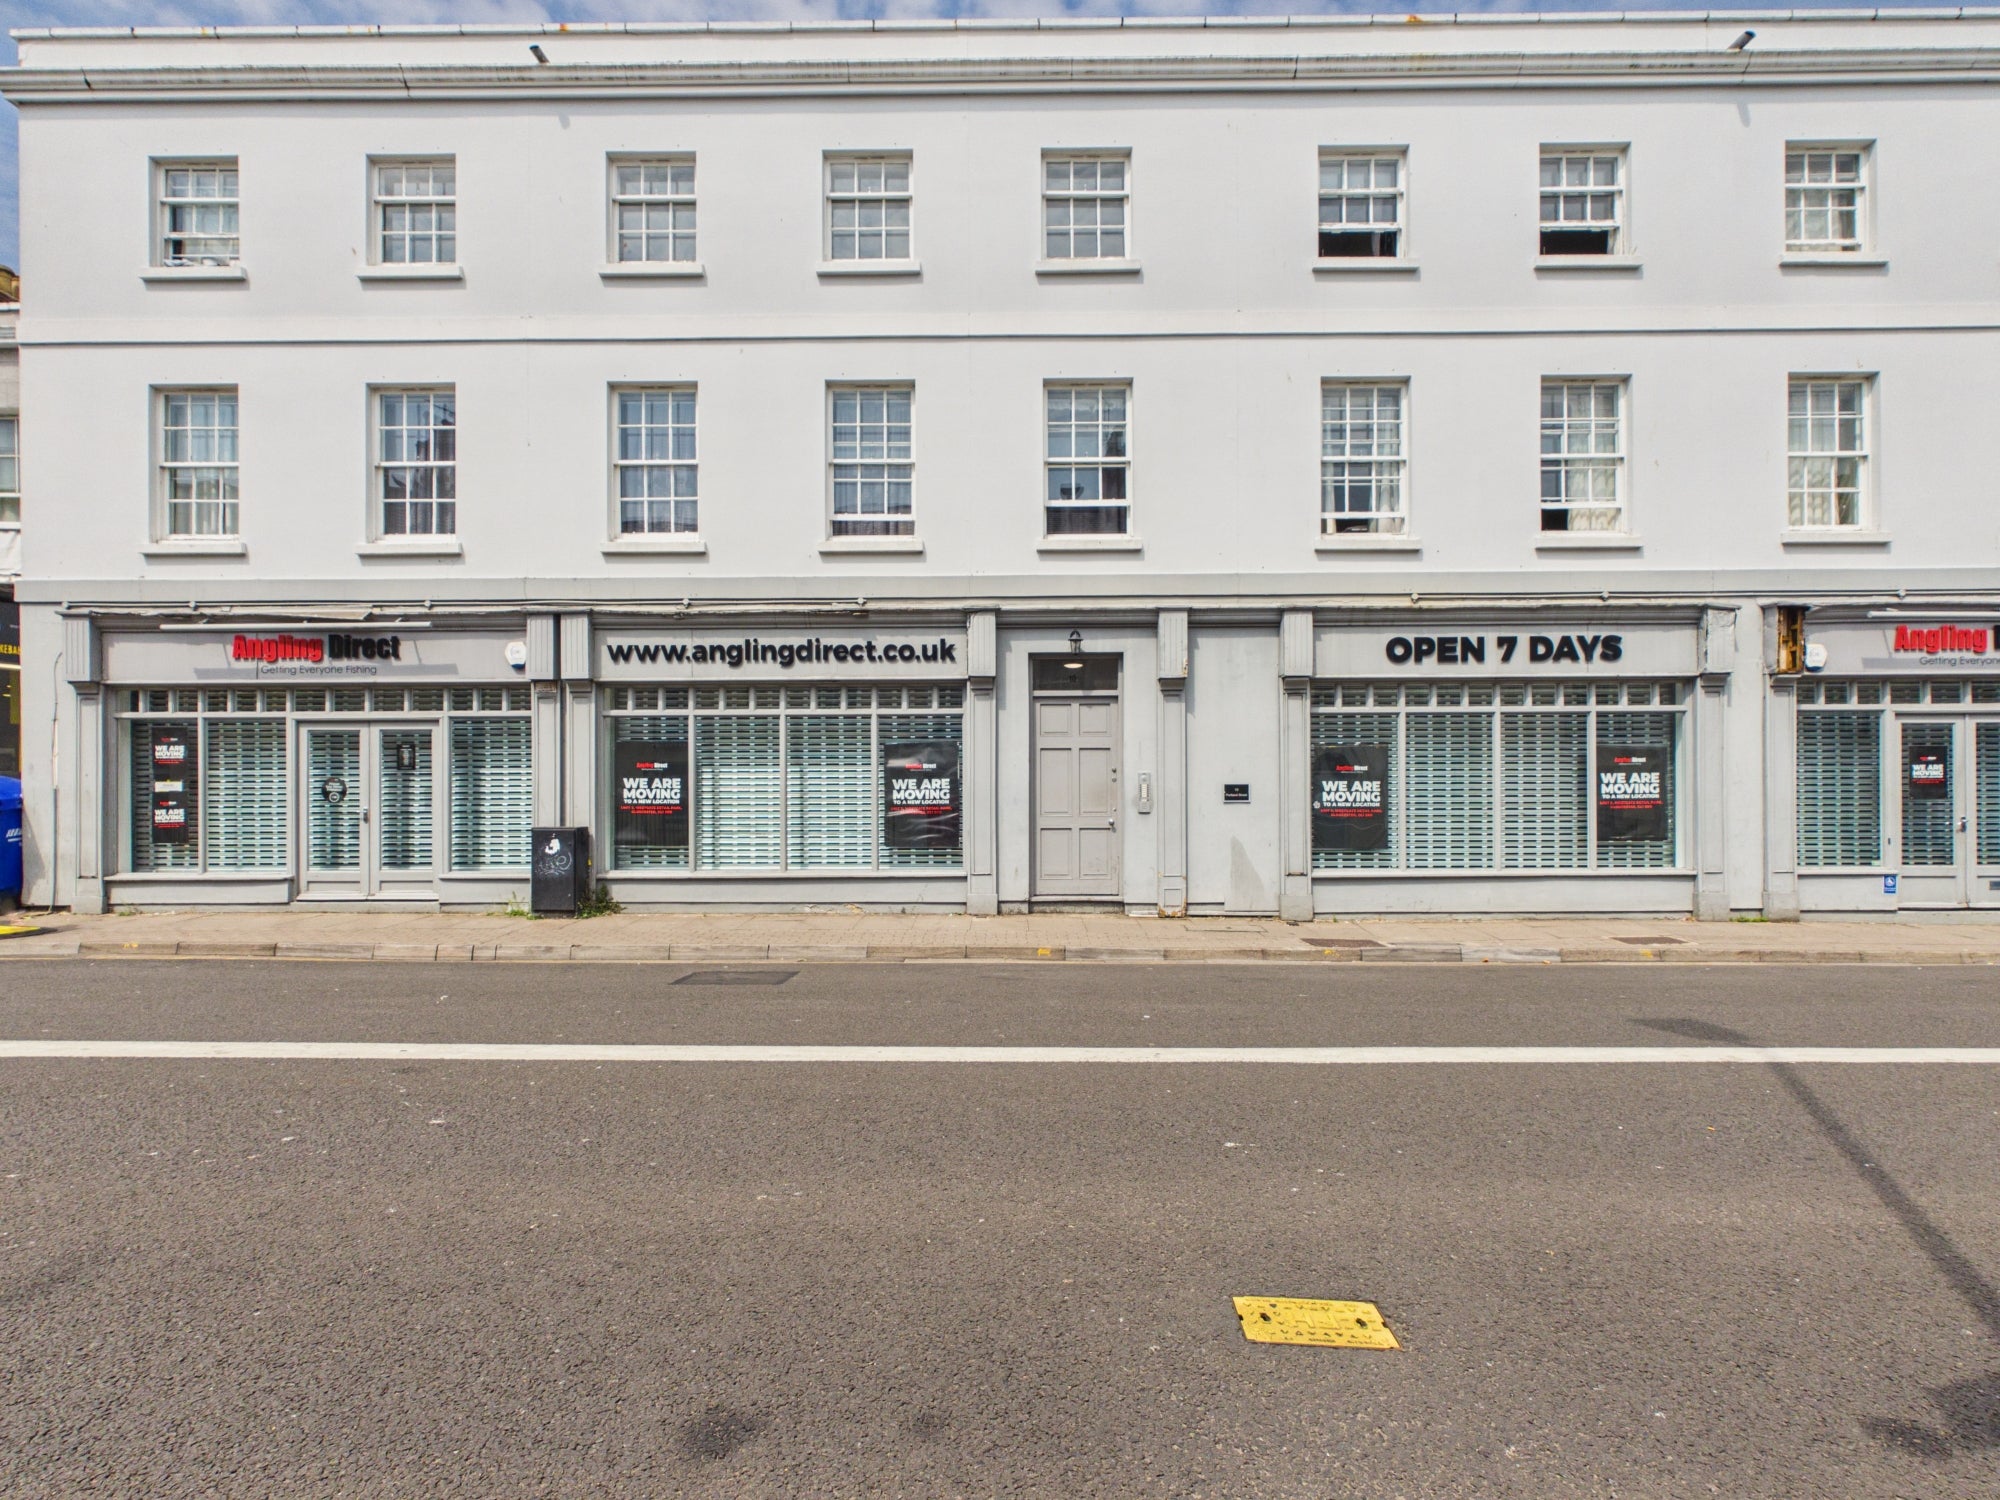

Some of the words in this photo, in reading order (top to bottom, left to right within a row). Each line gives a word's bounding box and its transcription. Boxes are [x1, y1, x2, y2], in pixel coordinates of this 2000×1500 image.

[1894, 625, 1987, 654] Angling
[232, 634, 324, 663] Angling
[328, 634, 402, 660] Direct
[607, 638, 956, 668] www.anglingdirect.co.uk
[1386, 636, 1485, 664] OPEN
[1497, 635, 1518, 663] 7
[1530, 635, 1623, 663] DAYS
[1919, 656, 1957, 667] Getting
[260, 665, 297, 676] Getting
[299, 665, 343, 676] Everyone
[345, 665, 378, 676] Fishing
[623, 777, 648, 788] WE
[651, 777, 681, 788] ARE
[1600, 772, 1626, 783] WE
[1629, 772, 1660, 783] ARE
[892, 778, 917, 789] WE
[920, 778, 950, 789] ARE
[1322, 780, 1348, 791] WE
[1350, 780, 1381, 791] ARE
[1600, 783, 1660, 794] MOVING
[623, 788, 681, 799] MOVING
[892, 789, 950, 800] MOVING
[1322, 791, 1381, 802] MOVING
